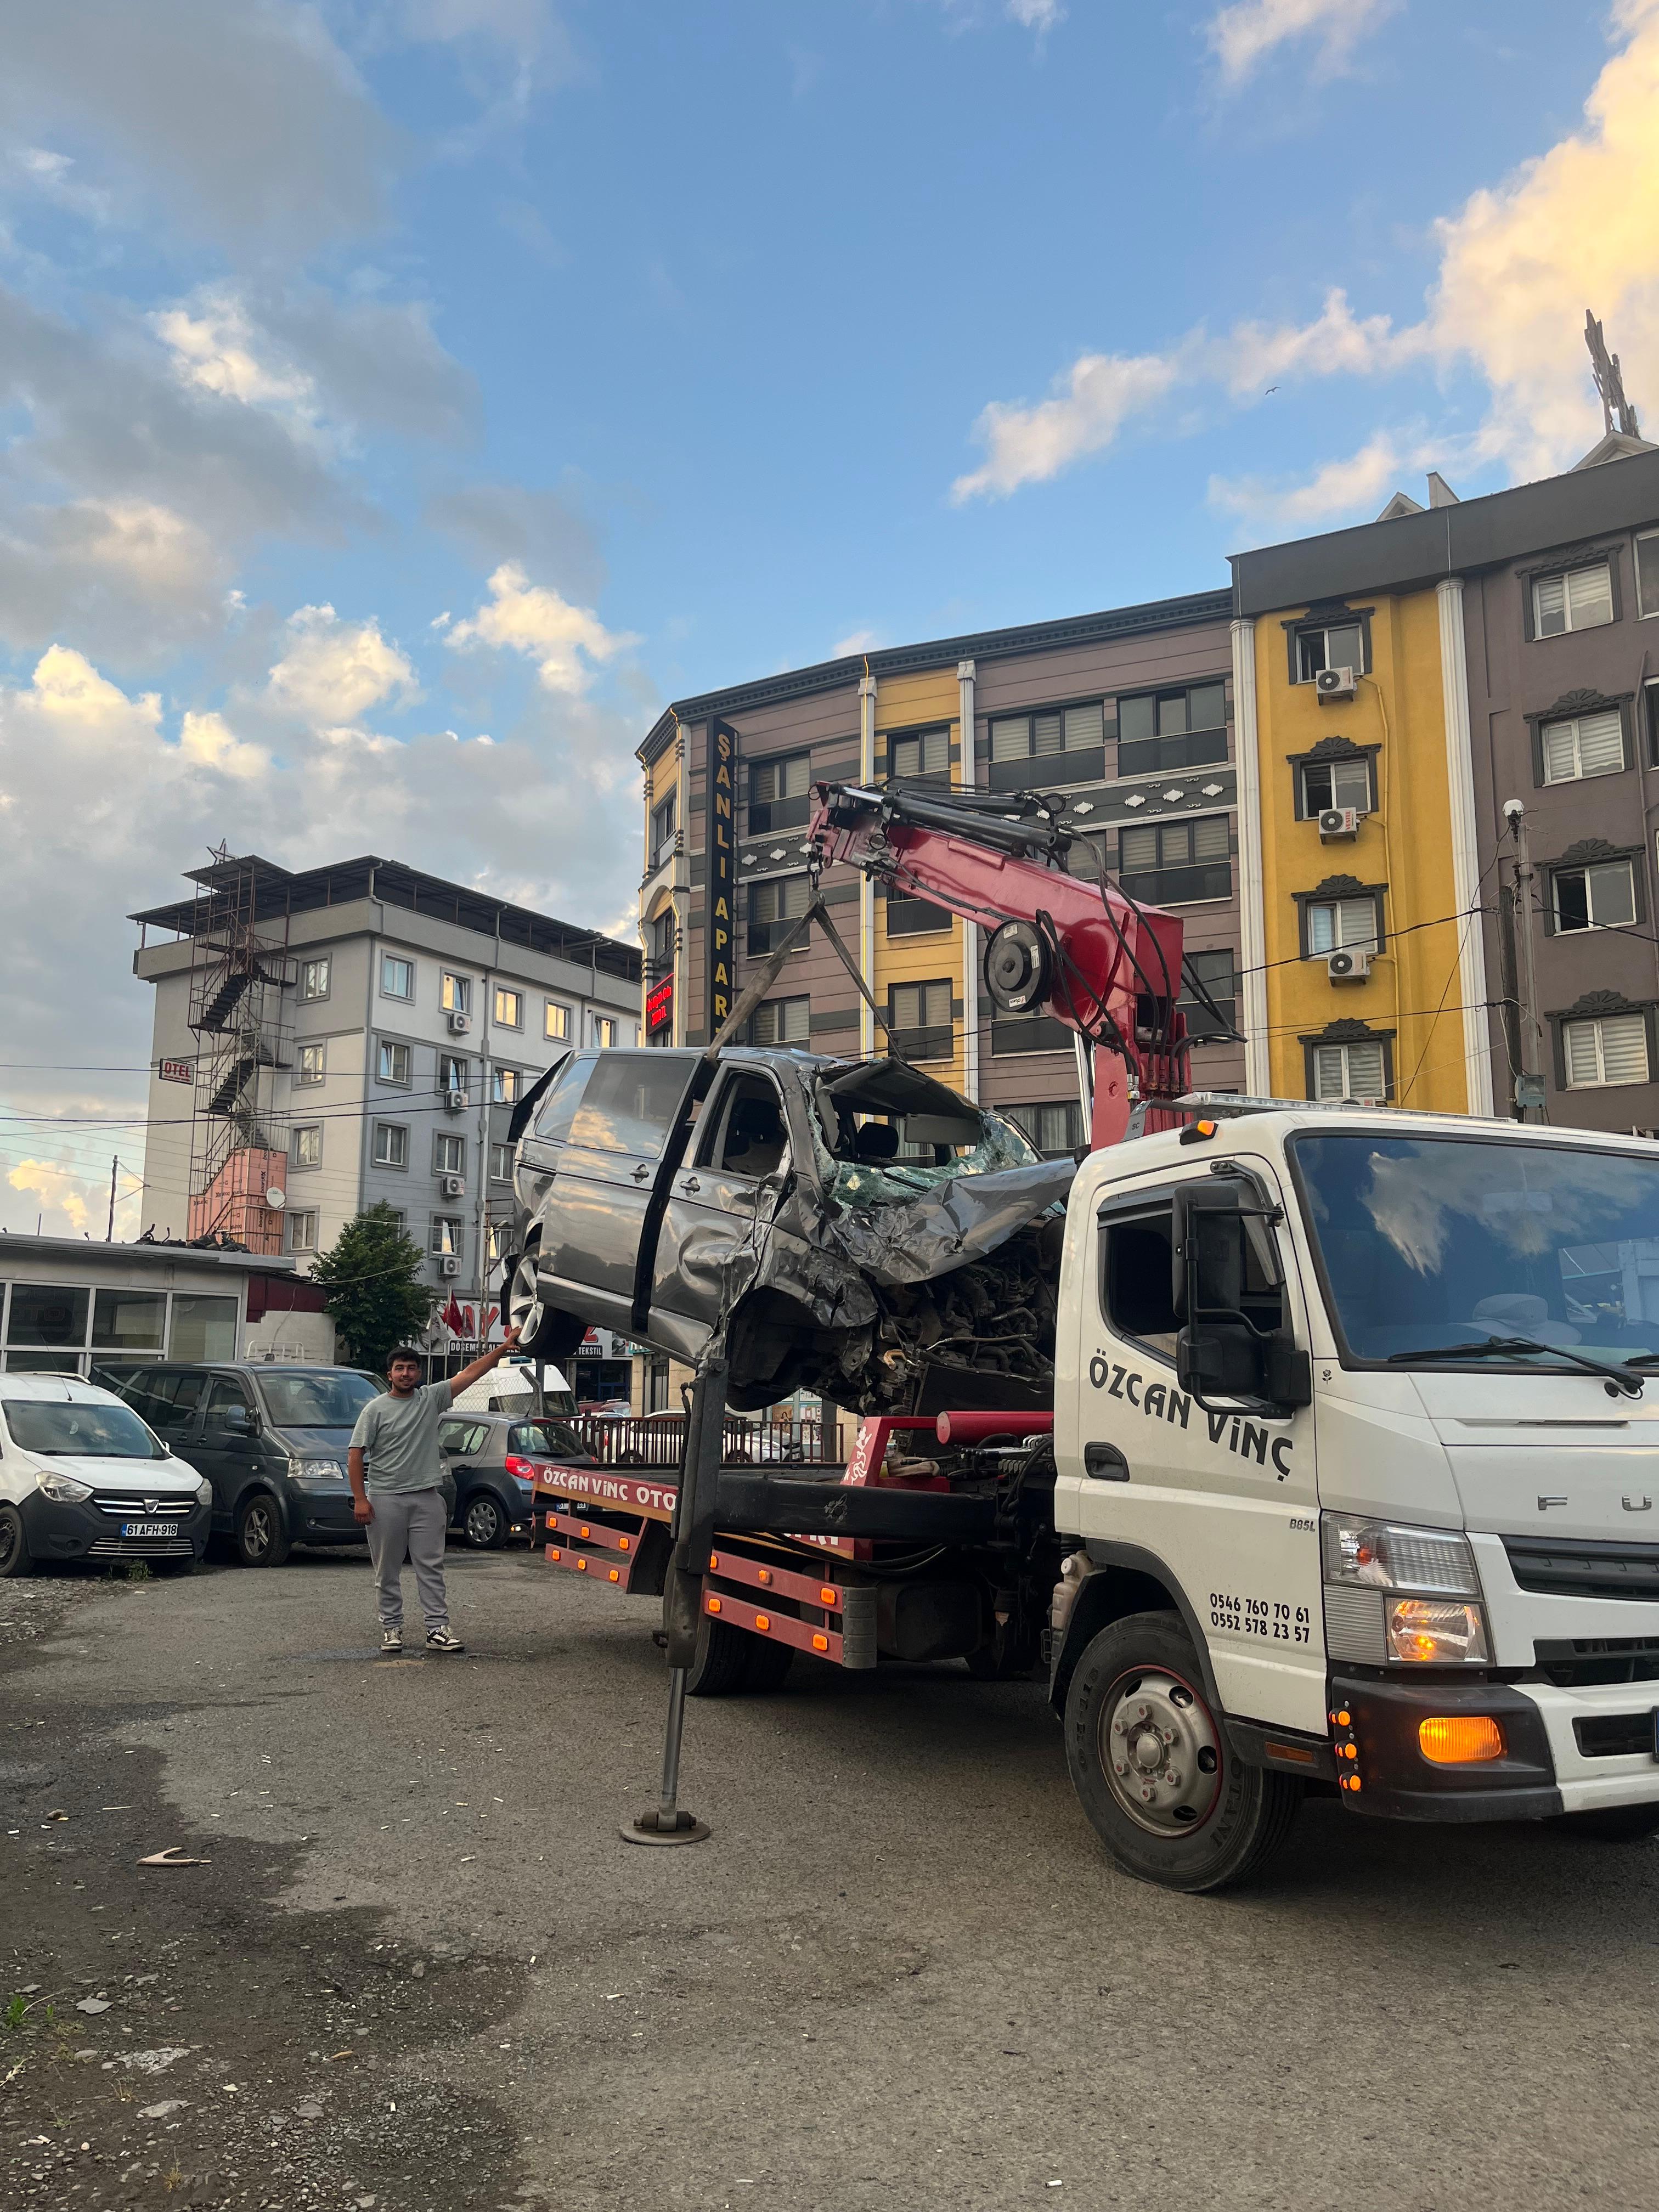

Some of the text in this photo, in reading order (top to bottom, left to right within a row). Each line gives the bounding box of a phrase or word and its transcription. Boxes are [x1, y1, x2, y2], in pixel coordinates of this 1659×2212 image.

[714, 733, 731, 1035] ŞANLI APAR
[165, 1062, 190, 1078] OTEL
[1090, 1348, 1192, 1430] ÖZCAN
[544, 1467, 589, 1492] ÖZCAN
[636, 1487, 676, 1511] OTO
[127, 1525, 177, 1534] 61 AFH 918
[1289, 1518, 1316, 1532] B85L
[1210, 1593, 1310, 1623] 0546 760 70 61
[1211, 1611, 1310, 1643] 0552 578 23 57
